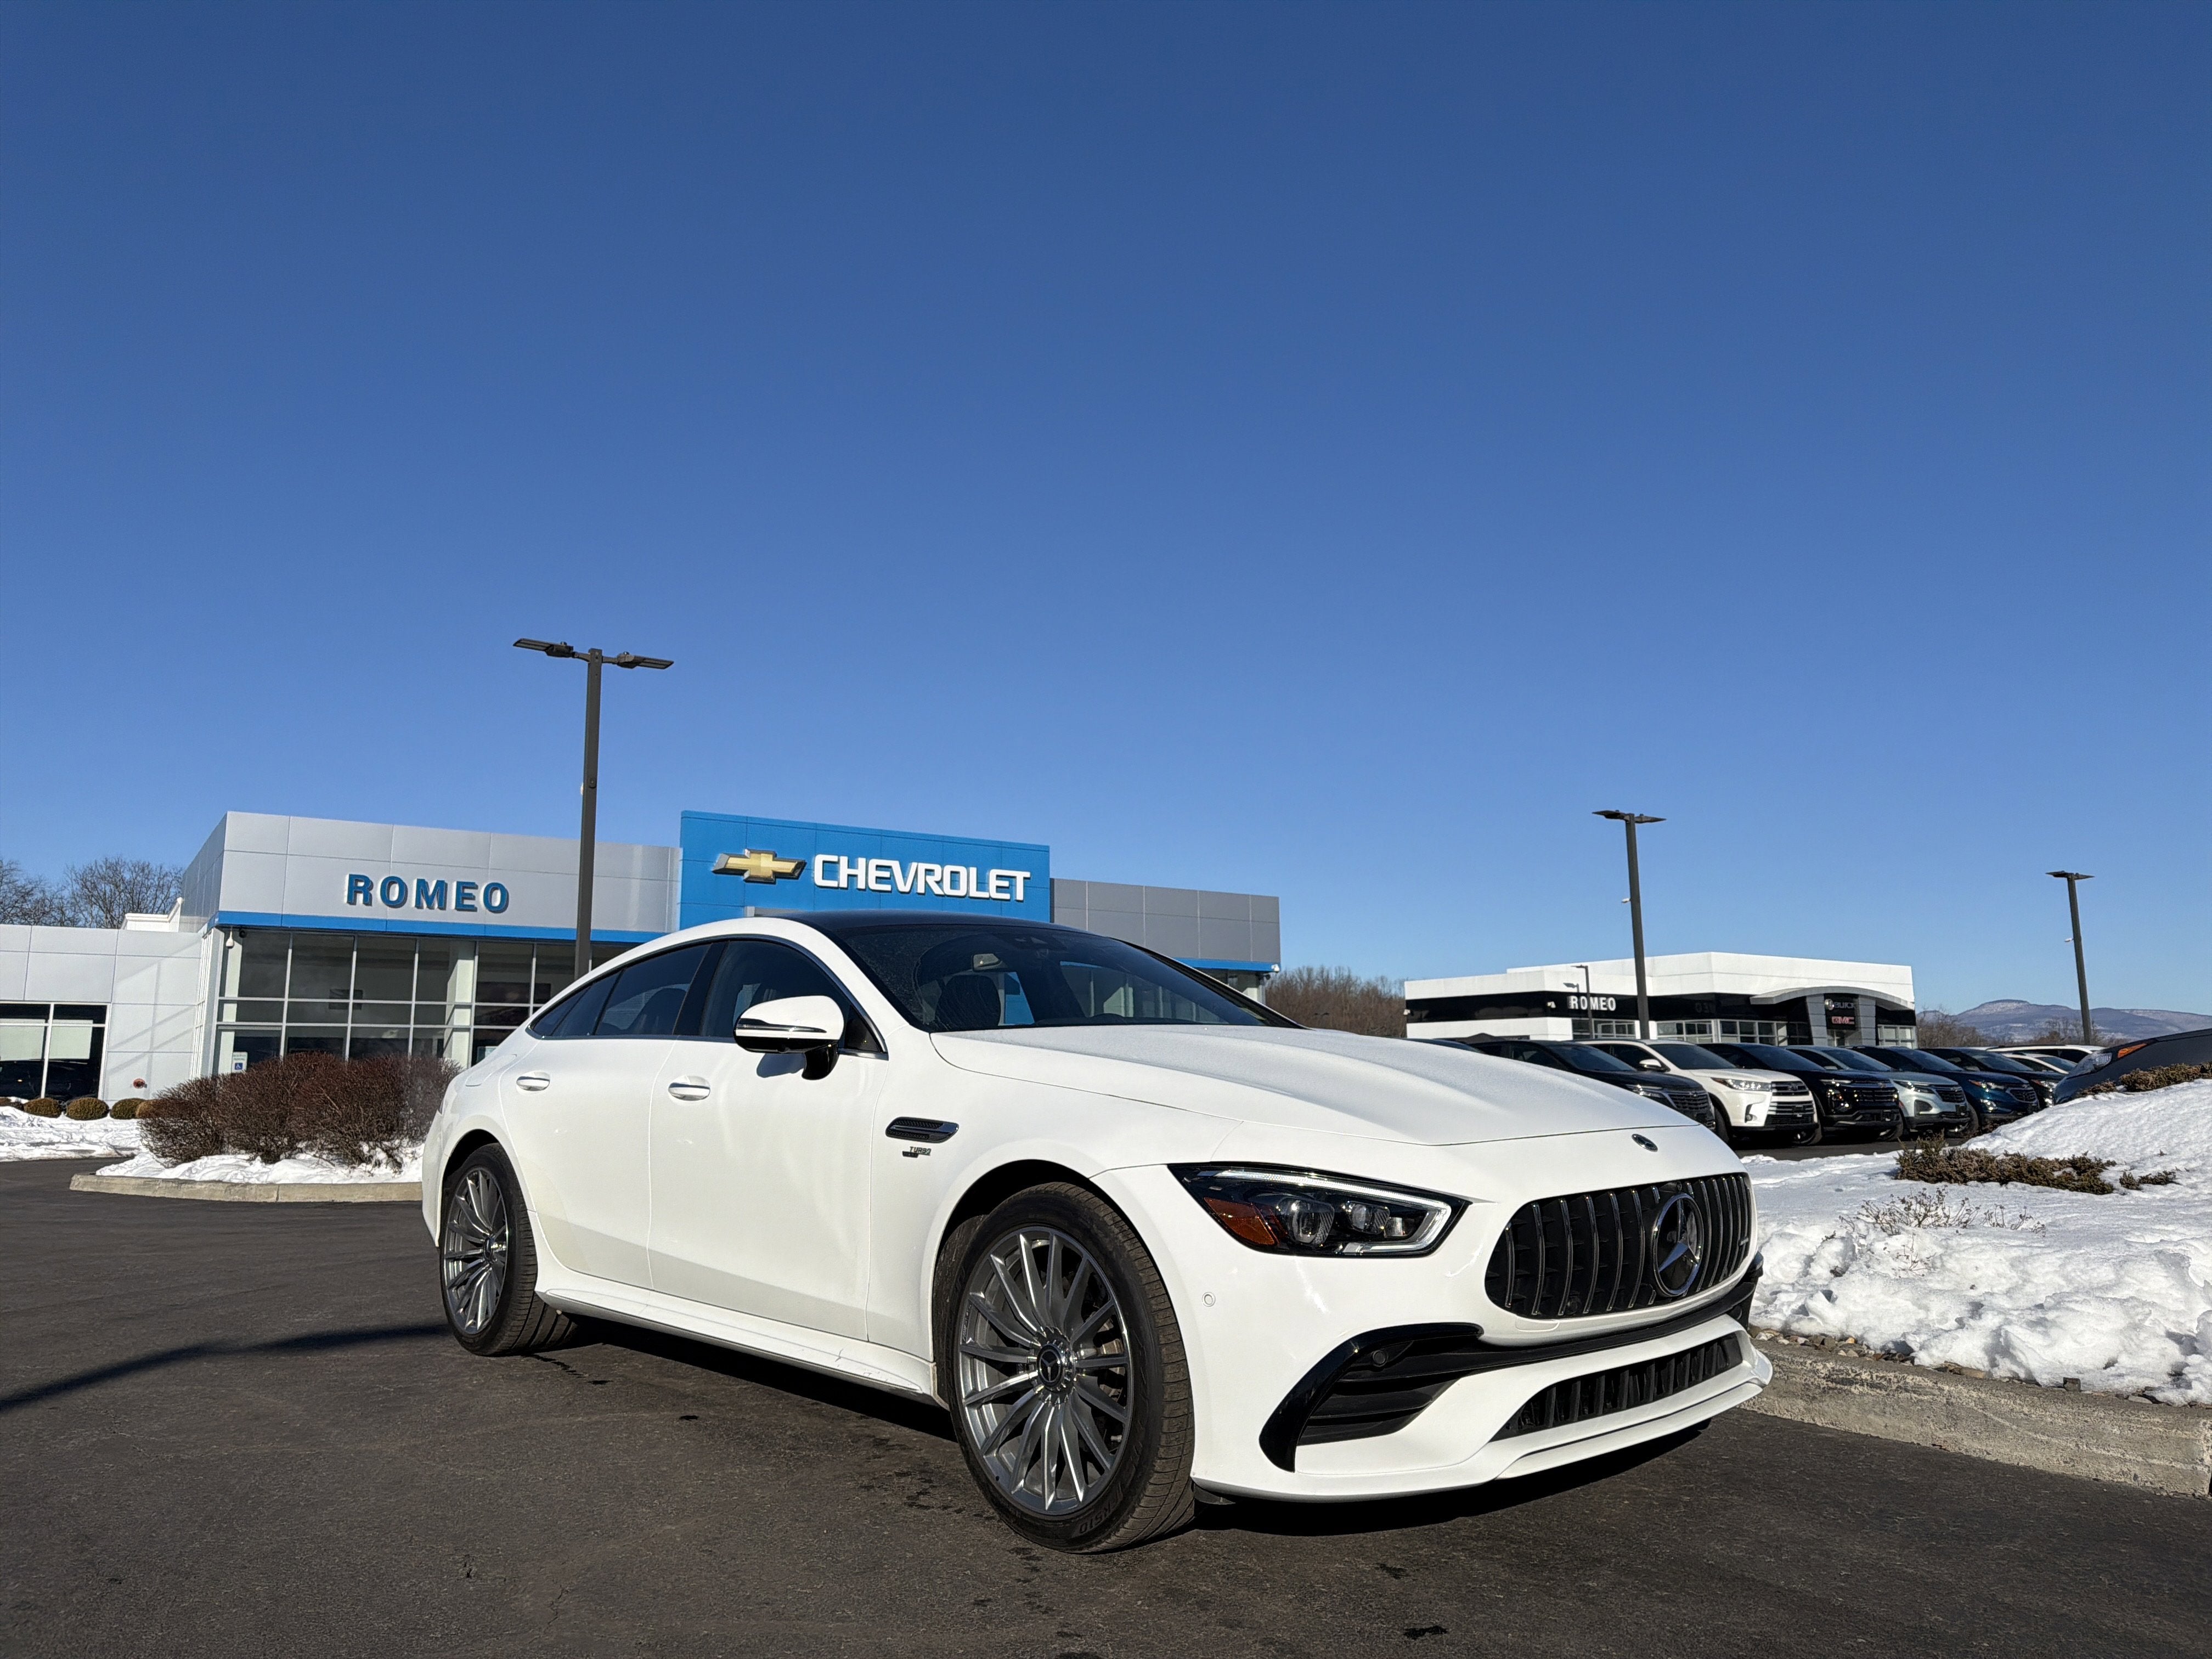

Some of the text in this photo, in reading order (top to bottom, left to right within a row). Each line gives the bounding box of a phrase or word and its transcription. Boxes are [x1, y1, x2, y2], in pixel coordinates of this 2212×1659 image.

[814, 854, 1031, 901] CHEVROLET
[345, 873, 510, 914] ROMEO
[1567, 995, 1616, 1011] ROMEO
[1831, 1016, 1855, 1025] GMC
[910, 1146, 932, 1156] TURBO
